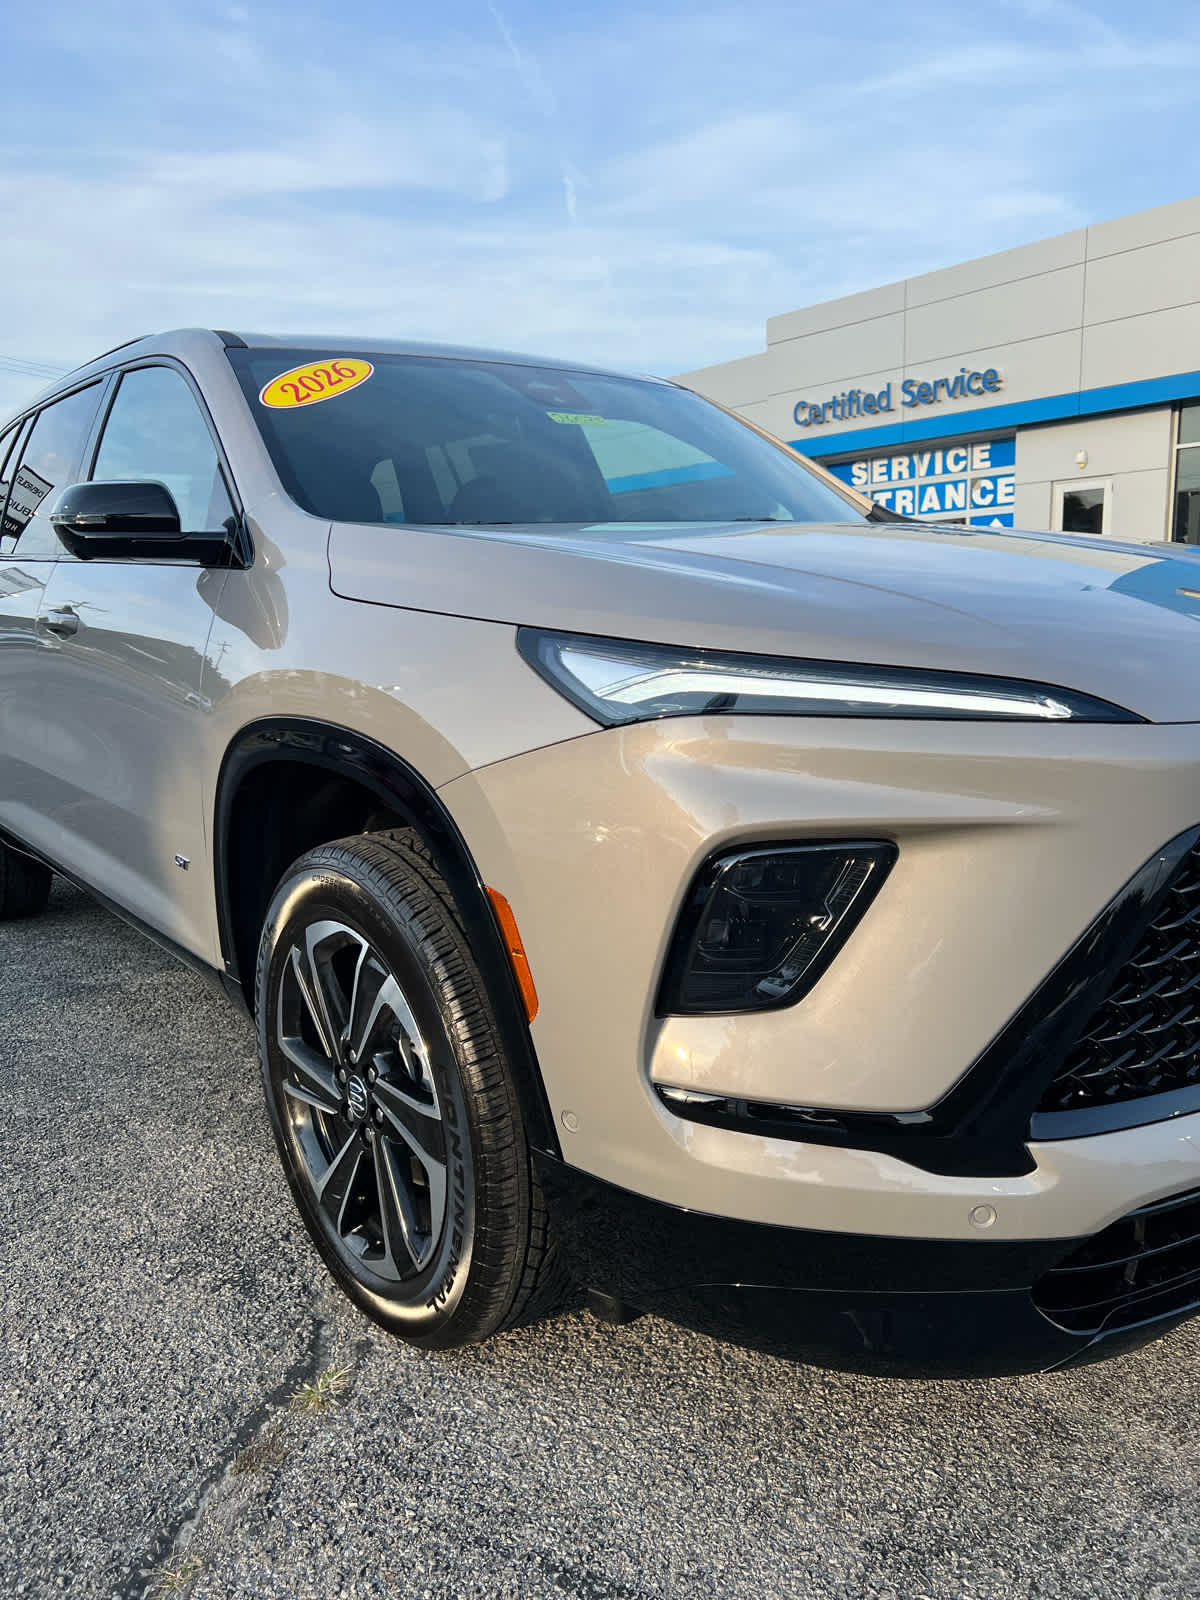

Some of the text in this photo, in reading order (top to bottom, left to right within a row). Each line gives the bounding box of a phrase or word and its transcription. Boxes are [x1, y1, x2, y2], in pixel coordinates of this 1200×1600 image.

[280, 361, 356, 403] 2026
[793, 367, 1002, 426] Certified Service
[851, 442, 992, 486] SERVICE
[871, 476, 1015, 516] TRANCE
[427, 1064, 466, 1315] CONTINENTAL
